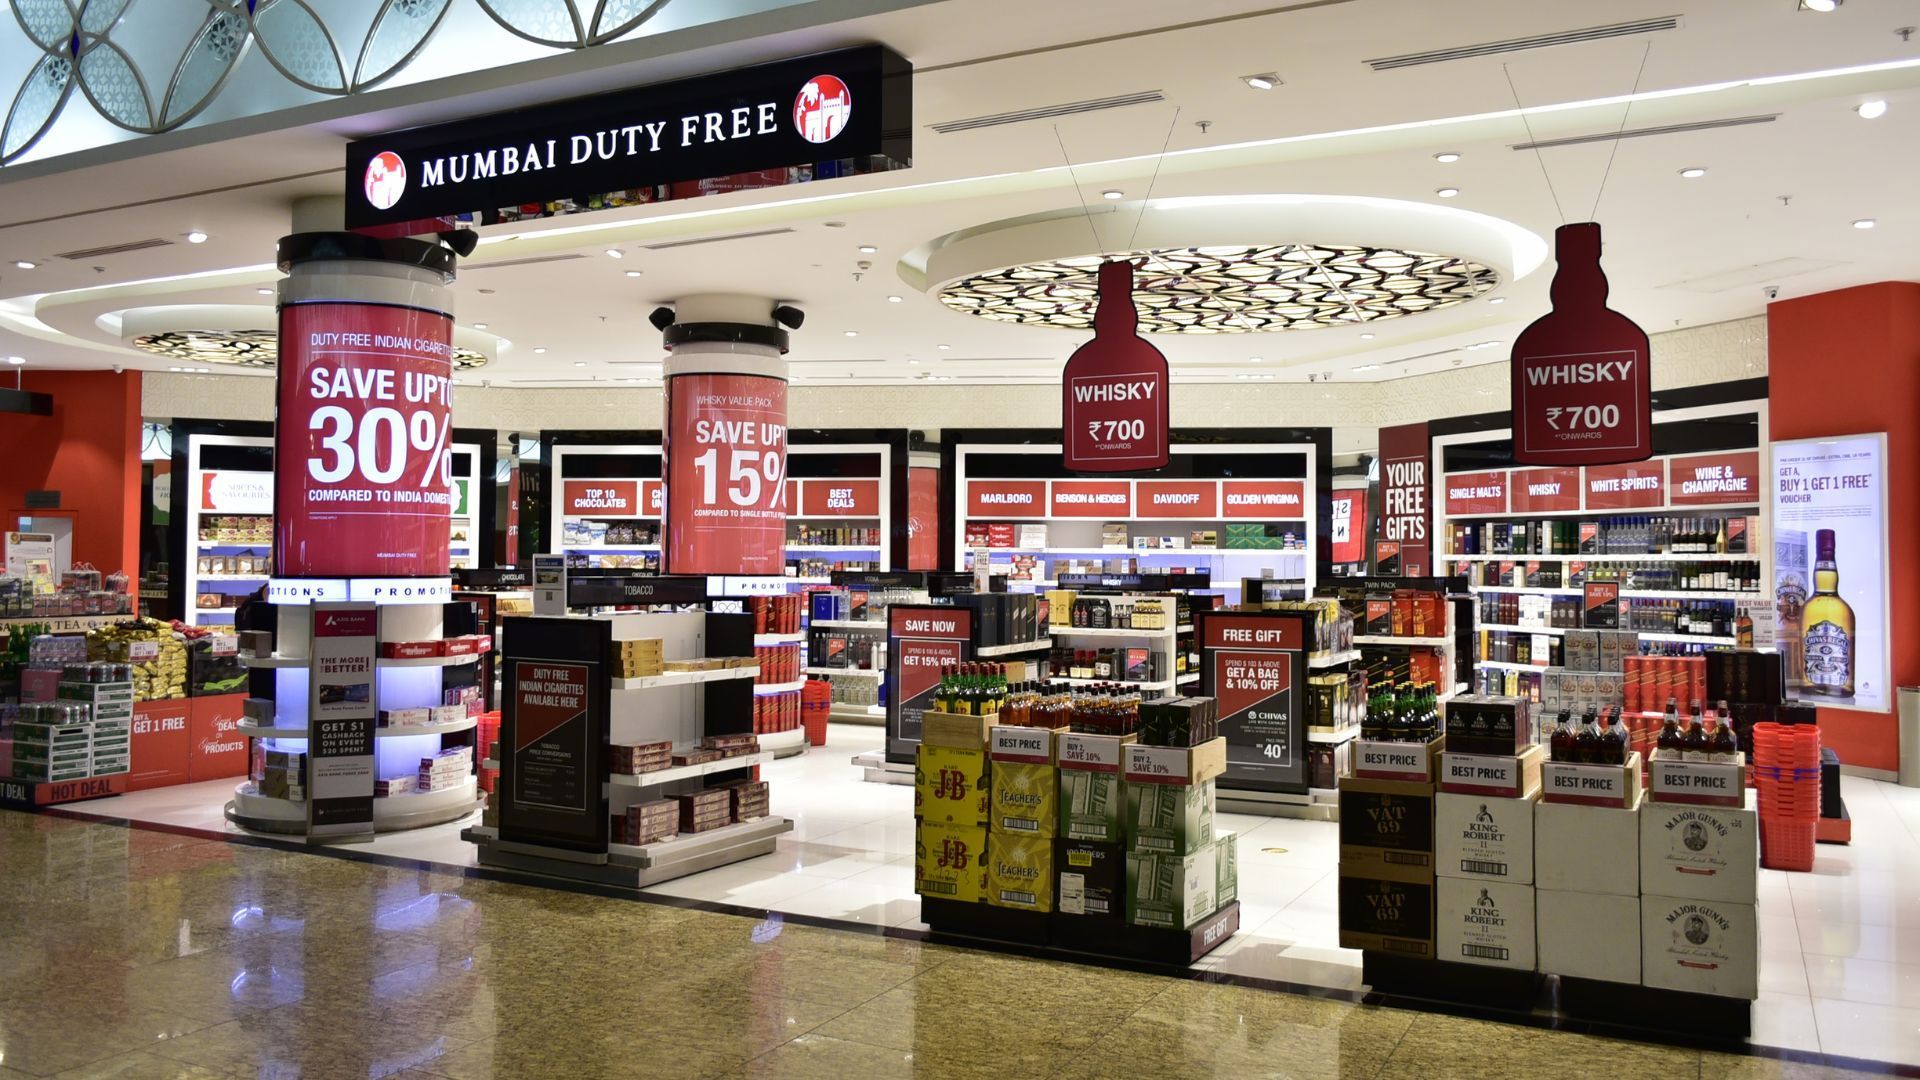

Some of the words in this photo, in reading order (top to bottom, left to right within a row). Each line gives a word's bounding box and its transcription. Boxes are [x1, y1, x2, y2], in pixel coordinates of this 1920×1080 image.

[420, 140, 556, 188] MUMBAI
[570, 121, 667, 165] DUTY
[681, 102, 778, 147] FREE
[311, 333, 340, 346] DUTY
[343, 334, 371, 347] FREE
[375, 335, 411, 350] INDIAN
[1527, 360, 1633, 386] WHISKY
[310, 367, 395, 400] SAVE
[1075, 382, 1155, 403] WHISKY
[696, 396, 727, 405] WHISKY
[728, 397, 753, 406] VALUE
[755, 398, 772, 408] PACK
[695, 421, 755, 445] SAVE
[308, 406, 452, 488] 30%
[1386, 461, 1425, 487] YOUR
[1695, 466, 1722, 480] WINE
[1724, 465, 1733, 478] &
[1780, 467, 1792, 476] GET
[1528, 483, 1561, 496] WHISKY
[1590, 479, 1619, 493] WHITE
[1620, 477, 1658, 491] SPIRITS
[1682, 478, 1747, 494] CHAMPAGNE
[1780, 479, 1800, 492] BUY
[1802, 478, 1808, 491] 1
[1811, 477, 1831, 490] GET
[1833, 476, 1839, 489] 1
[308, 489, 372, 502] COMPARED
[376, 490, 391, 502] TO
[394, 491, 422, 503] INDIA
[586, 489, 603, 498] TOP
[605, 489, 615, 498] 10
[829, 489, 852, 498] BEST
[981, 493, 1032, 504] MARLBORO
[1055, 493, 1087, 504] BENSON
[1088, 494, 1094, 504] &
[1095, 493, 1127, 504] HEDGES
[1153, 493, 1200, 504] DAVIDOFF
[1226, 494, 1261, 505] GOLDEN
[1262, 494, 1299, 505] VIRGINIA
[1449, 487, 1475, 500] SINGLE
[1476, 486, 1501, 498] MALTS
[1780, 494, 1811, 503] VOUCHER
[574, 498, 627, 508] CHOCOLATES
[827, 498, 854, 508] DEALS
[1386, 487, 1425, 515] FREE
[694, 509, 728, 517] COMPARED
[730, 509, 739, 517] TO
[1386, 516, 1425, 540] GIFTS
[501, 573, 525, 581] CHOCOLATE
[624, 585, 654, 595] TOBACCO
[1364, 581, 1379, 589] TWIN
[1380, 581, 1397, 589] PACK
[55, 620, 80, 630] TEA
[905, 620, 930, 632] SAVE
[932, 621, 955, 632] NOW
[1223, 629, 1252, 642] FREE
[1255, 630, 1282, 643] GIFT
[904, 656, 919, 665] GET
[921, 657, 939, 666] 15%
[1225, 659, 1242, 667] SPEND
[1263, 660, 1280, 669] ABOVE
[534, 668, 552, 679] DUTY
[552, 669, 569, 681] FREE
[1226, 667, 1245, 678] GET
[1248, 668, 1256, 678] A
[1257, 668, 1279, 679] BAG
[520, 680, 543, 692] INDIAN
[544, 682, 584, 695] CIGARETTES
[1226, 679, 1234, 688] &
[1237, 679, 1257, 690] 10%
[1260, 679, 1279, 690] OFF
[524, 693, 560, 706] AVAILABLE
[560, 696, 579, 708] HERE
[1258, 712, 1287, 721] CHIVAS
[134, 720, 152, 733] GET
[154, 720, 160, 731] 1
[162, 717, 185, 730] FREE
[218, 721, 237, 731] DEAL
[321, 723, 345, 732] GET
[322, 732, 365, 740] CASHBACK
[205, 742, 243, 754] PRODUCTS
[339, 739, 365, 747] EVERY
[999, 738, 1017, 748] BEST
[1019, 739, 1041, 750] PRICE
[340, 746, 364, 754] SPENT
[1067, 751, 1084, 760] SAVE
[1086, 752, 1101, 761] 10%
[1264, 743, 1281, 759] 40
[1133, 755, 1145, 763] BUY
[1365, 753, 1386, 765] BEST
[1389, 754, 1417, 766] PRICE
[1133, 763, 1151, 773] SAVE
[1153, 764, 1169, 774] 10%
[1451, 765, 1475, 777] BEST
[1477, 767, 1506, 780] PRICE
[934, 769, 966, 800] J&B
[1555, 775, 1579, 788] BEST
[1582, 778, 1612, 790] PRICE
[1664, 774, 1691, 786] BEST
[1694, 776, 1727, 788] PRICE
[6, 784, 27, 800] DEAL
[51, 783, 77, 800] HOT
[81, 779, 112, 797] DEAL
[1000, 789, 1042, 804] TEACHER'S
[1366, 806, 1407, 821] VAT
[1377, 820, 1401, 834] 69
[1665, 811, 1696, 831] MAJOR
[1469, 823, 1498, 833] KING
[1463, 831, 1505, 842] ROBERT
[1480, 840, 1487, 848] II
[937, 839, 968, 870] J&B
[998, 861, 1040, 878] TEACHER'S
[1365, 893, 1405, 907] VAT
[1376, 907, 1400, 921] 69
[1470, 907, 1499, 917] KING
[1666, 905, 1697, 924] MAJOR
[1464, 915, 1506, 926] ROBERT
[1203, 924, 1216, 946] FREE
[1216, 917, 1228, 937] GIFT
[1481, 925, 1488, 933] II
